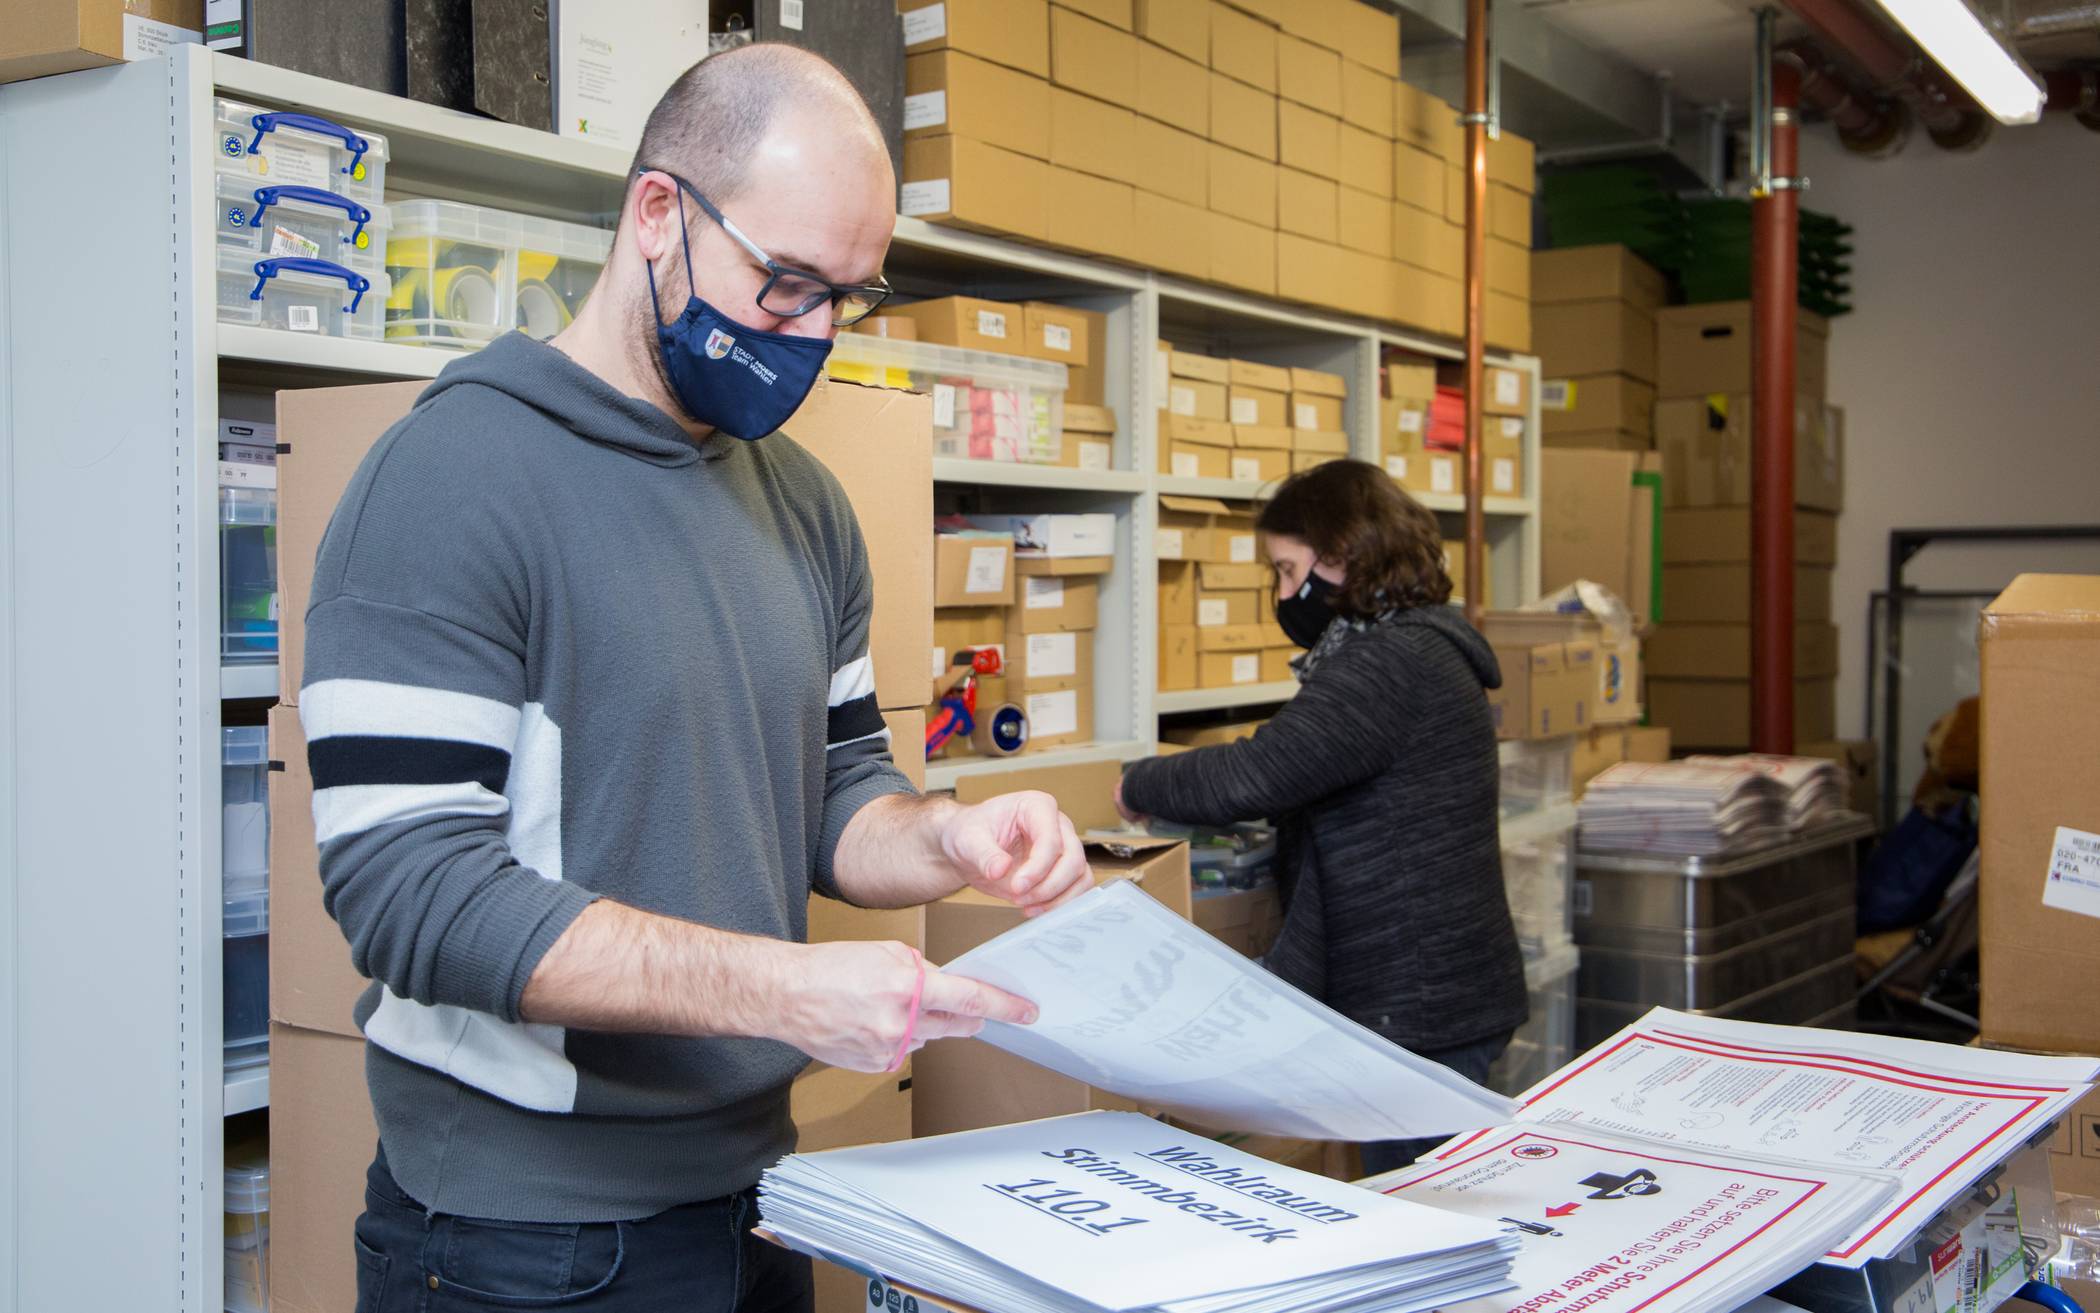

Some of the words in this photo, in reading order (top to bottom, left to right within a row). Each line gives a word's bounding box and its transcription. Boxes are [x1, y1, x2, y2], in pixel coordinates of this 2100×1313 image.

[731, 352, 749, 367] Team
[750, 363, 774, 386] Wahlen
[734, 346, 755, 362] STADT
[754, 361, 778, 381] MOERS
[2057, 861, 2080, 873] FRA
[1041, 1148, 1298, 1244] Stimmbezirk
[1148, 1146, 1360, 1223] Wahlraum
[1718, 1183, 1745, 1199] auf
[995, 1178, 1151, 1234] 110.1
[1694, 1197, 1721, 1217] und
[1741, 1188, 1779, 1210] Bitte
[1646, 1213, 1696, 1244] halten
[1690, 1210, 1742, 1239] setzen
[1609, 1255, 1632, 1265] 2
[1621, 1240, 1656, 1256] Sie
[1667, 1240, 1701, 1255] Sie
[1637, 1252, 1679, 1272] Ihre
[1561, 1262, 1620, 1292] Meter
[1506, 1288, 1568, 1313] Absta
[1555, 1271, 1647, 1313] Schutzma
